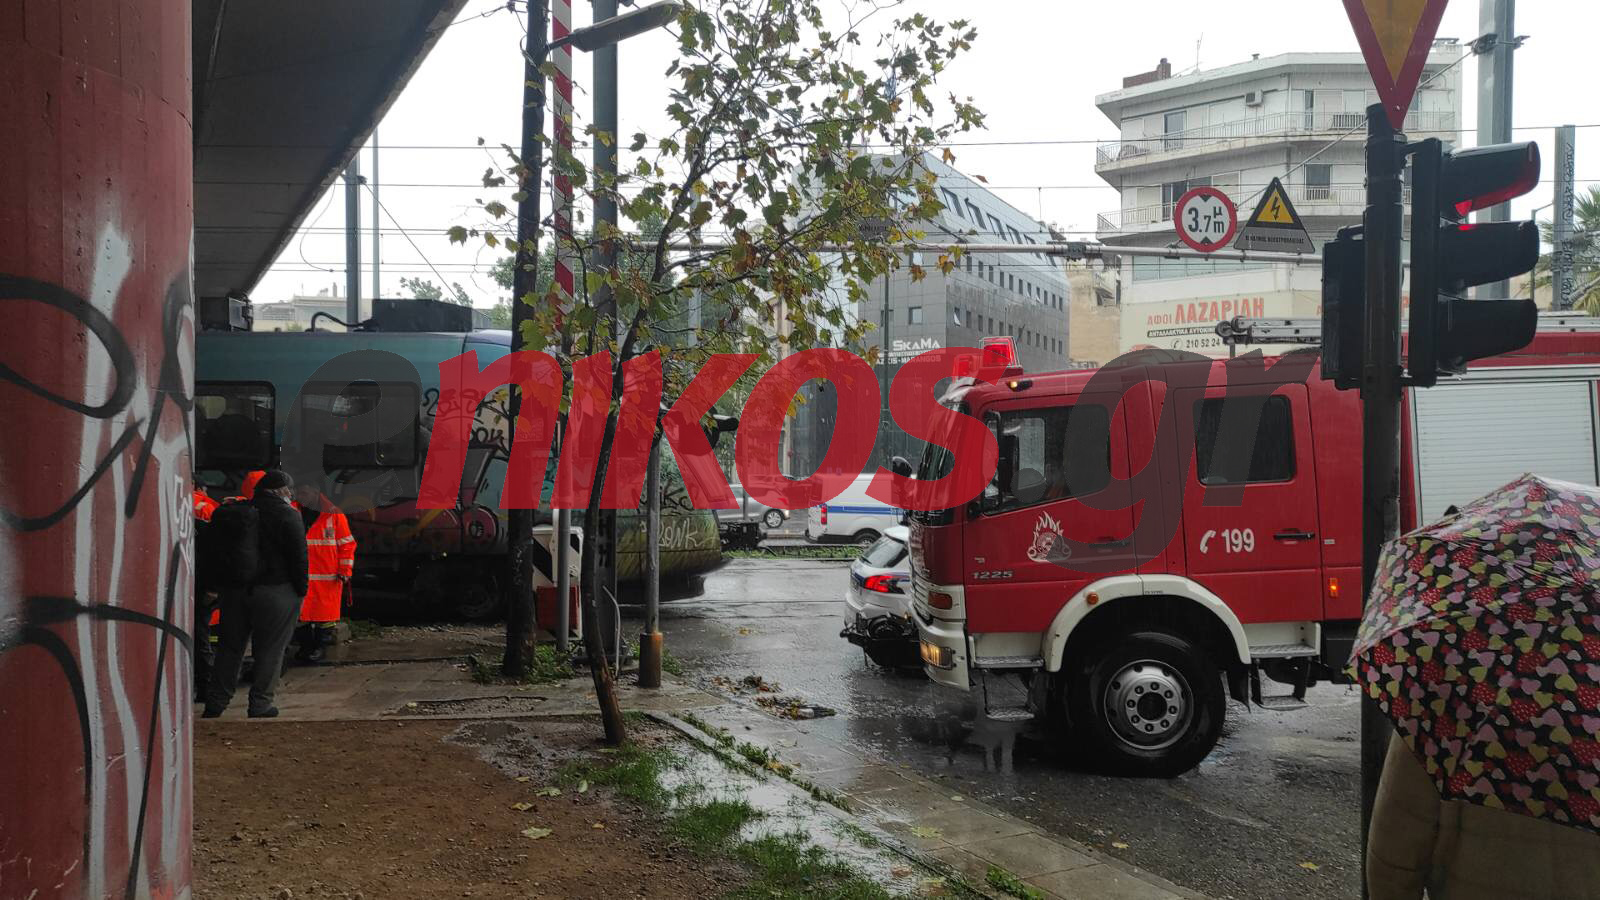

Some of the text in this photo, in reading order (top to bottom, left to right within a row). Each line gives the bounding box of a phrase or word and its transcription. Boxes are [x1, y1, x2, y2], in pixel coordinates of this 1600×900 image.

[1187, 207, 1212, 233] 3.7
[1186, 339, 1199, 348] 210
[1221, 528, 1255, 553] 199
[972, 570, 1013, 579] 1225
